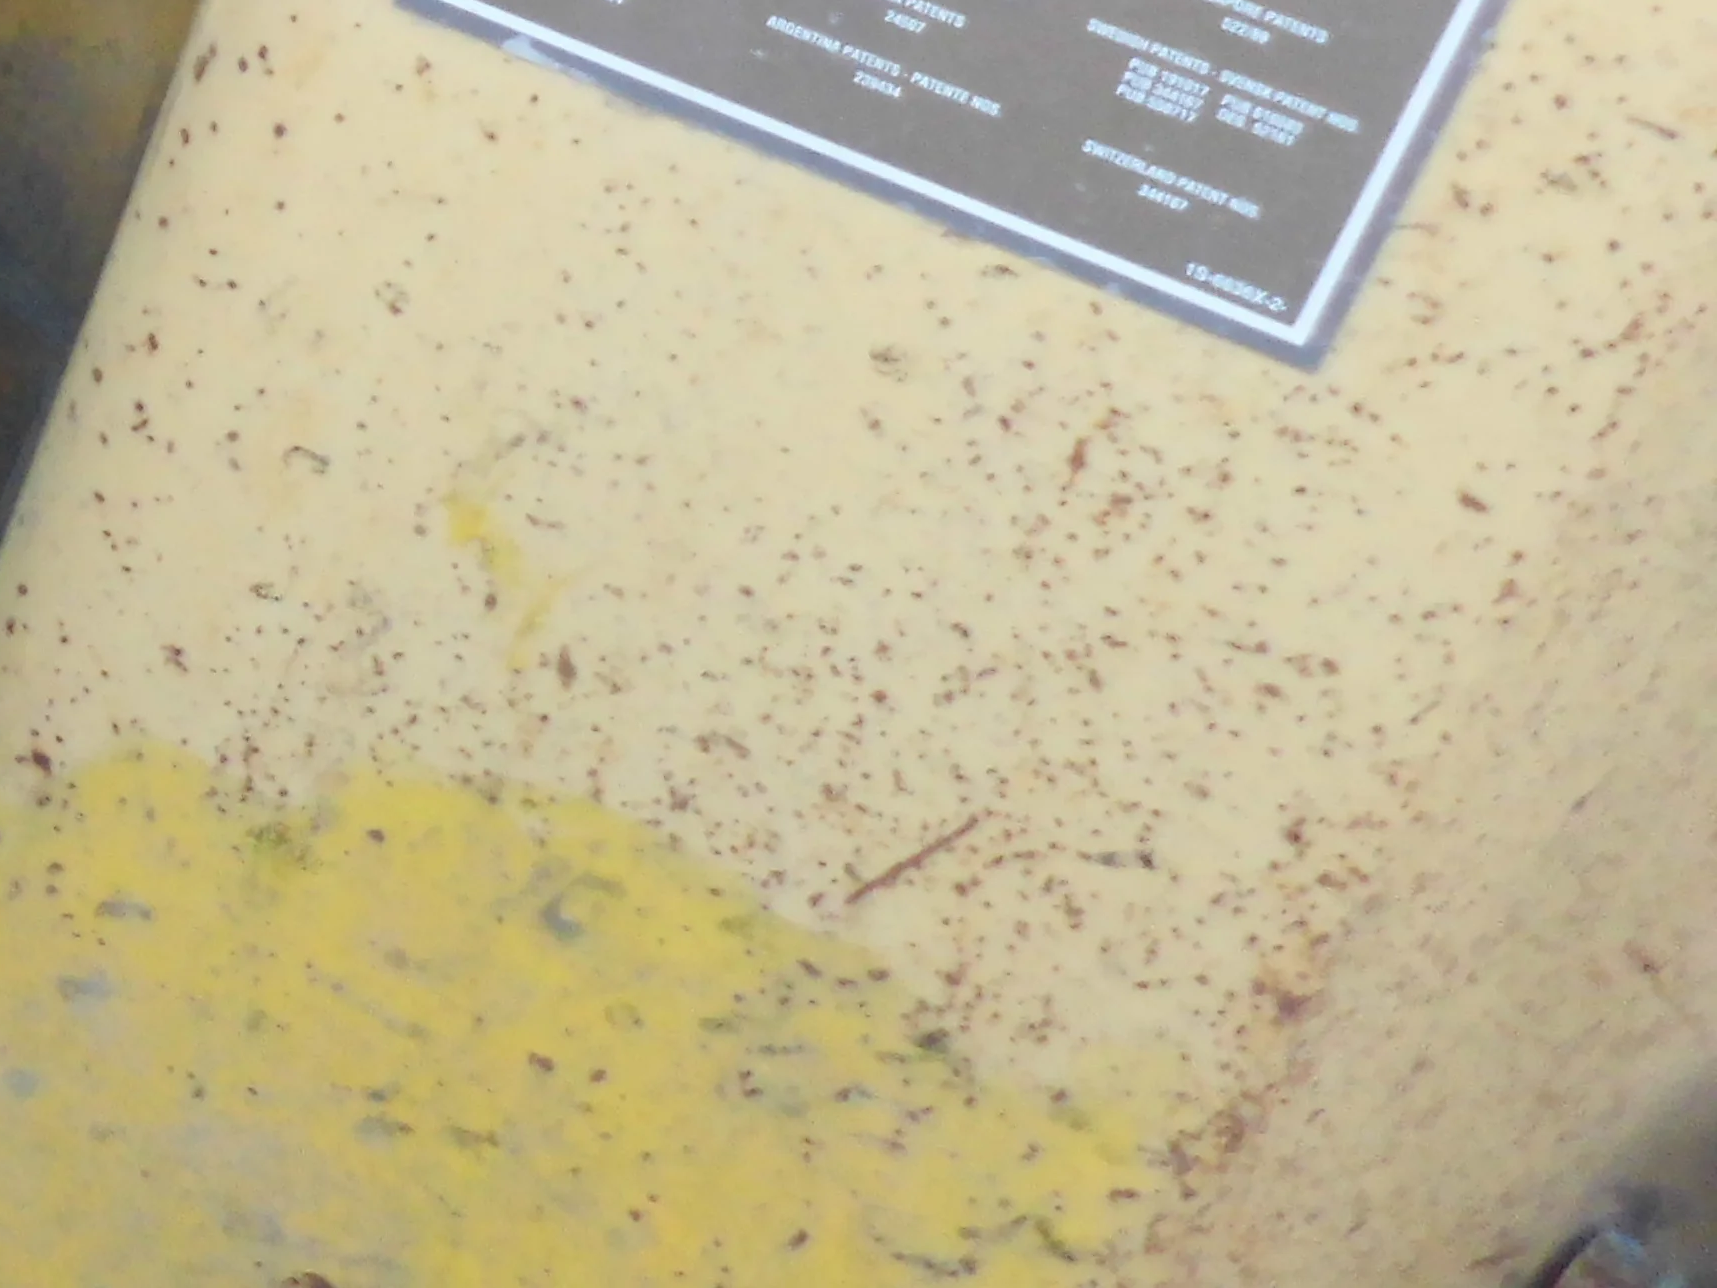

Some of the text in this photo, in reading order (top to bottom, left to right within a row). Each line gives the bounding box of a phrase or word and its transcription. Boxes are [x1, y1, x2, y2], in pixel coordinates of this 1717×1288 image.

[766, 15, 840, 52] ARGENTINA
[842, 45, 900, 76] PATENTS
[910, 71, 969, 103] PATENTE
[1264, 10, 1328, 43] PATENTS
[1149, 42, 1209, 74] PATENTS
[1273, 91, 1326, 118] PATENT
[1081, 139, 1176, 183] SWITZERLAND
[1176, 177, 1228, 204] PATENT
